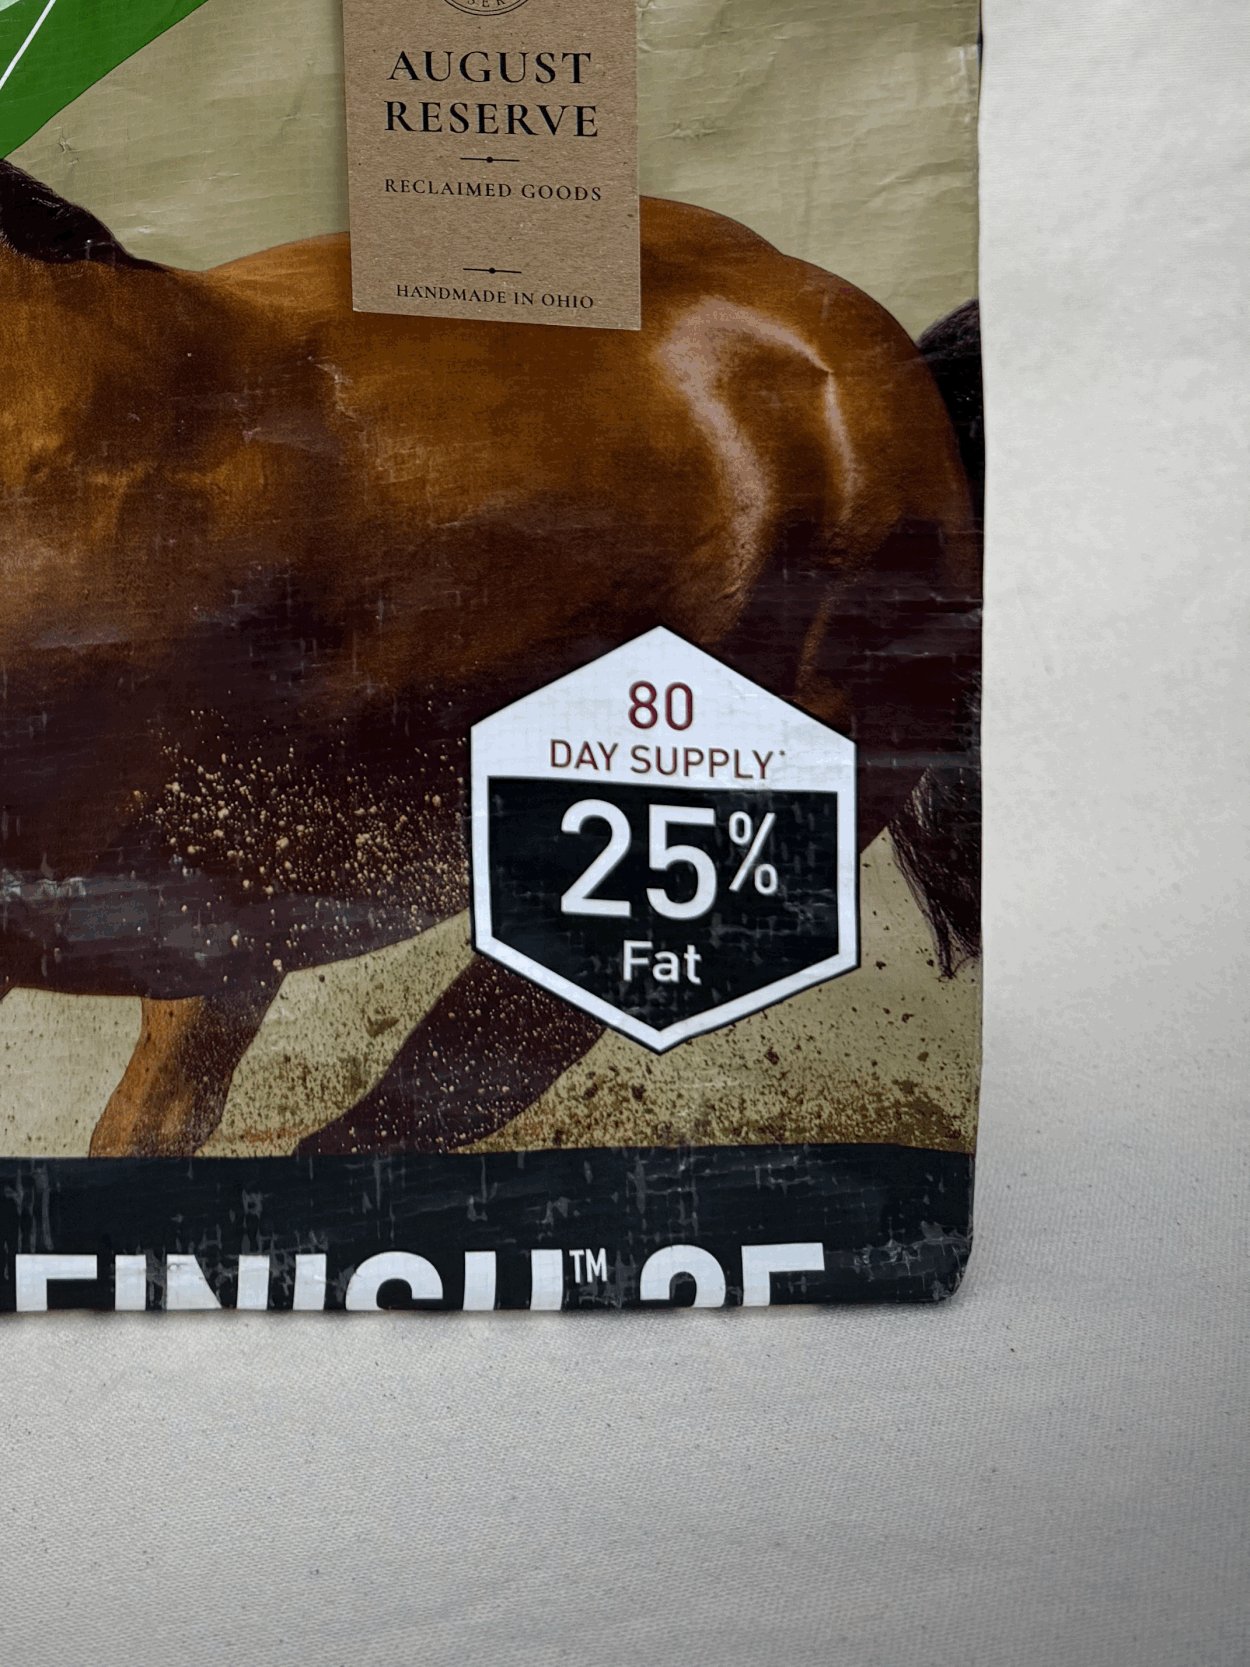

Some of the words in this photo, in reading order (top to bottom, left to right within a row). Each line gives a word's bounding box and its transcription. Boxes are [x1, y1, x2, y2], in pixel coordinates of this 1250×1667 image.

[386, 50, 592, 85] AUGUST
[384, 100, 599, 138] RESERVE
[384, 177, 513, 199] RECLAIMED
[521, 182, 603, 202] GOODS
[396, 283, 508, 306] HANDMADE
[513, 291, 536, 307] IN
[541, 293, 595, 310] OHIO
[628, 680, 694, 731] 80
[550, 739, 619, 771] DAY
[560, 798, 779, 920] 25%
[623, 940, 703, 985] Fat
